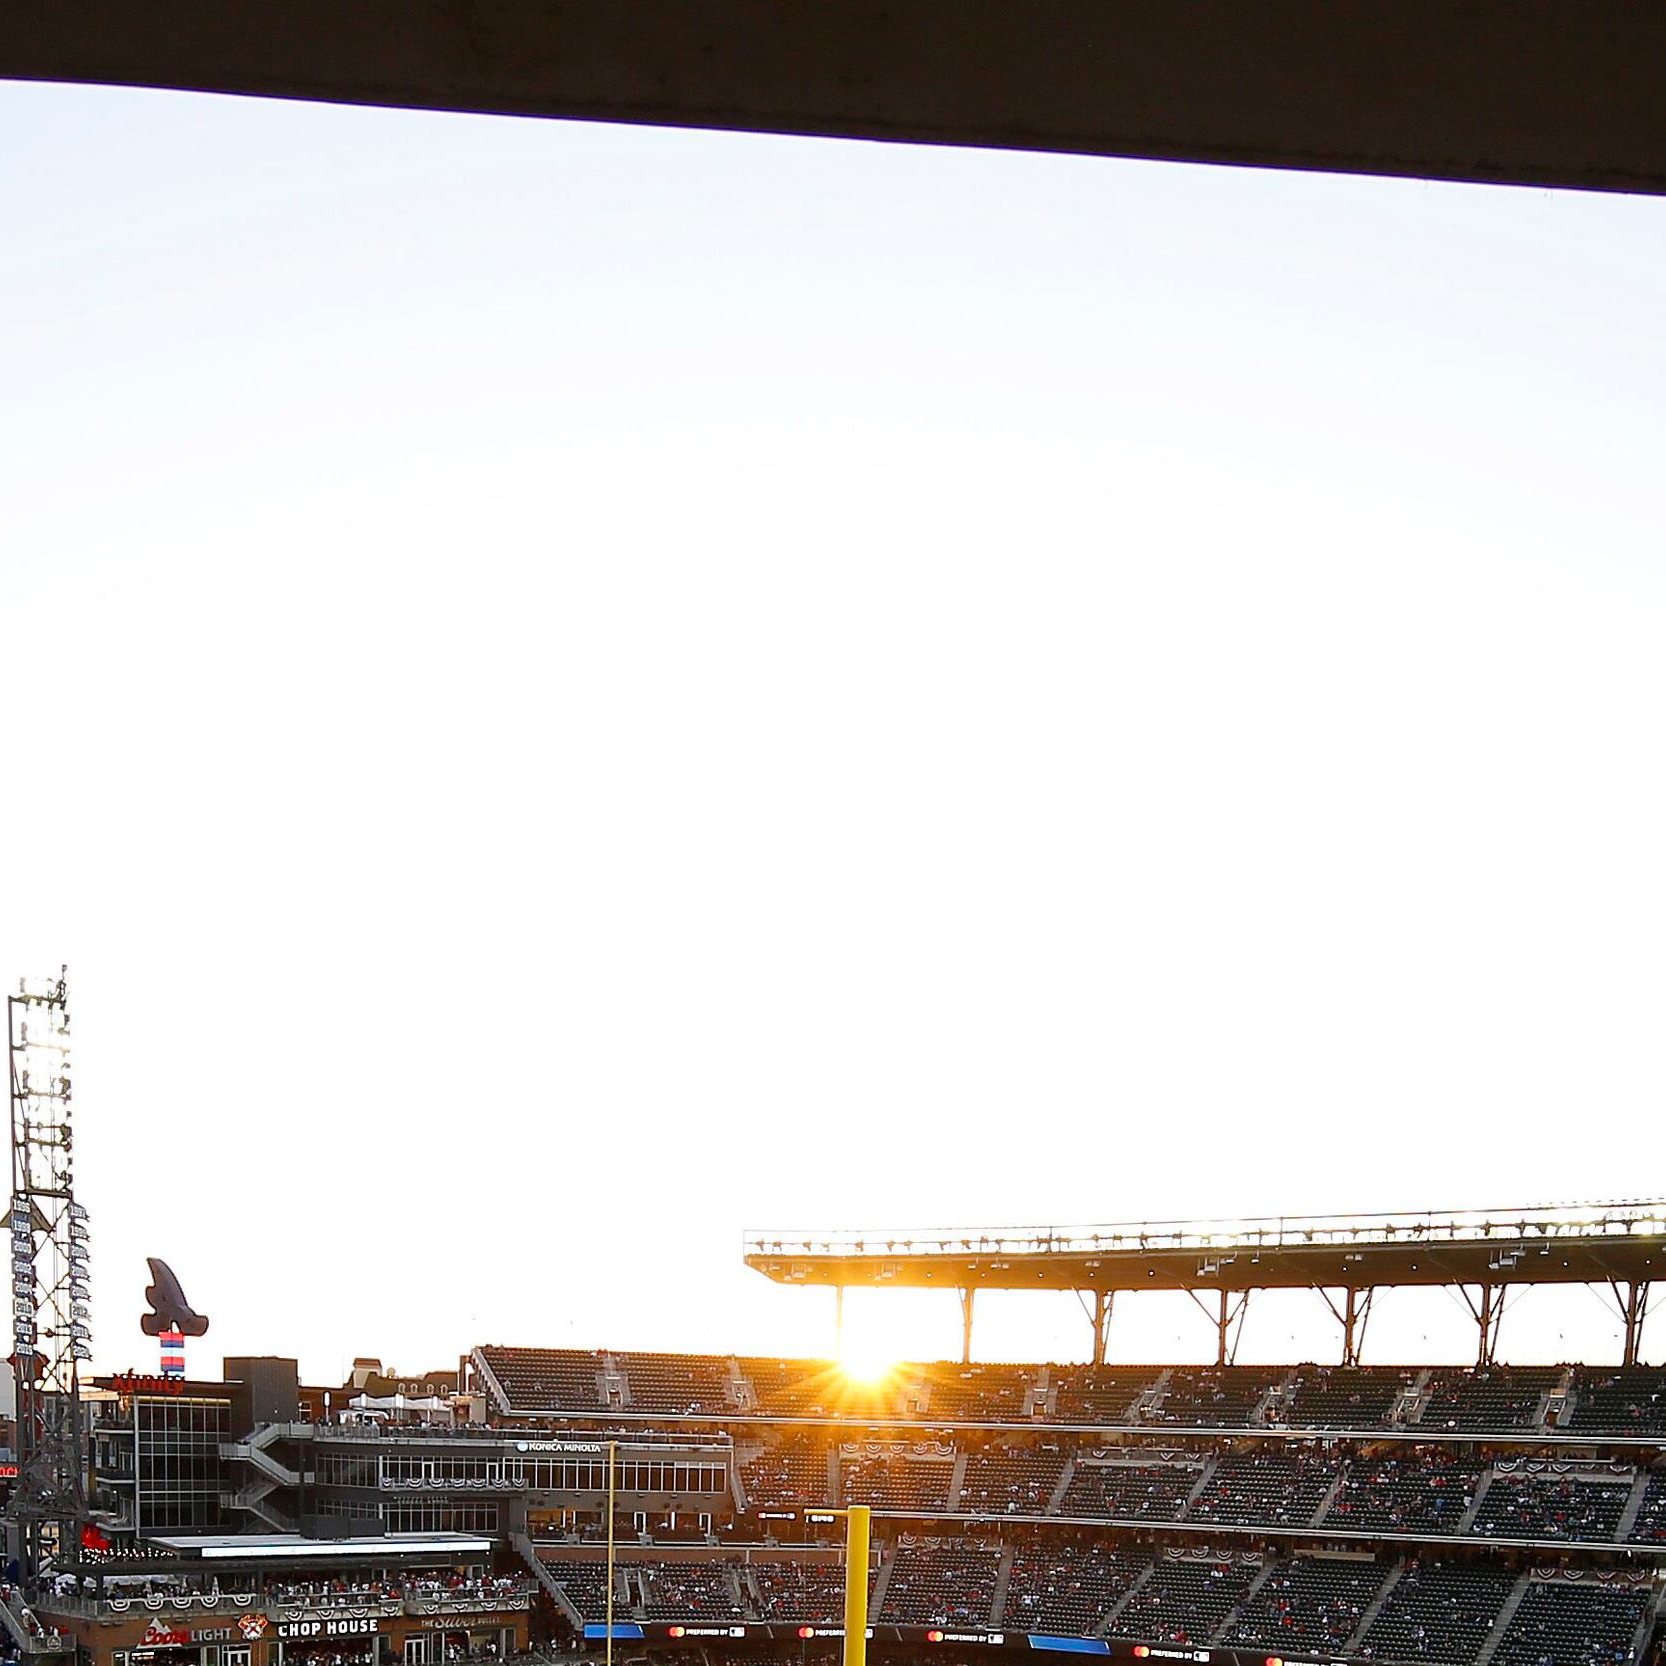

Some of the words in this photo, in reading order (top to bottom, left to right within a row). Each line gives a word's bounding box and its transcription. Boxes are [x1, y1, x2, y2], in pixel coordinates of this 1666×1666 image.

[529, 1443, 562, 1452] KONICA
[564, 1444, 601, 1452] MINOLTA
[191, 1628, 232, 1642] LIGHT
[278, 1621, 321, 1637] CHOP
[326, 1619, 378, 1634] HOUSE
